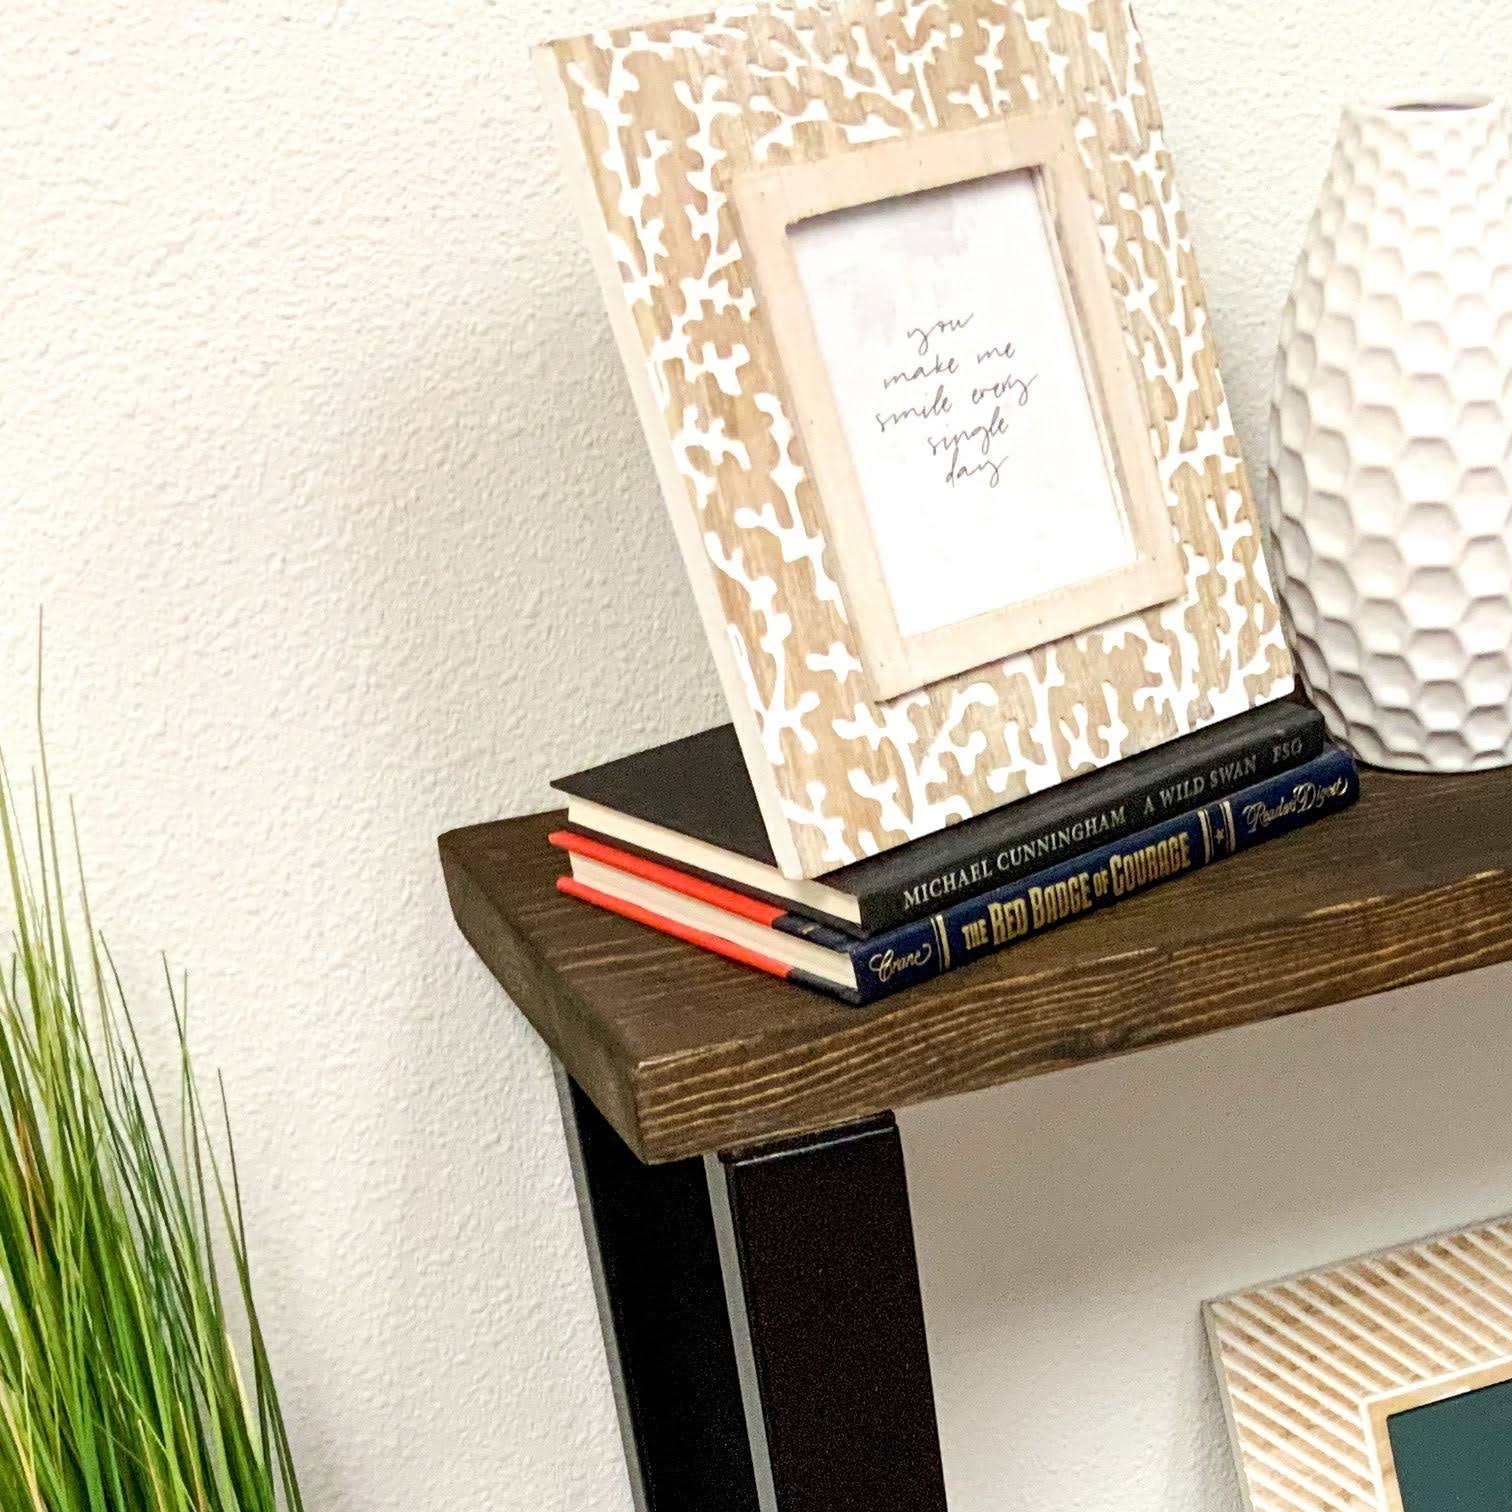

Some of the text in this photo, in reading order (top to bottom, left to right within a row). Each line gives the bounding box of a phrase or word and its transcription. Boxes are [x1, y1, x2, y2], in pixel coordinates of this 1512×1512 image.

[907, 313, 974, 355] you
[884, 342, 1015, 389] make me
[875, 374, 1038, 432] smile every
[927, 406, 1008, 456] single
[946, 448, 1008, 488] day
[903, 737, 1303, 910] MICHAEL CUNNINGHAM A WILD SWAN FSG
[869, 943, 932, 982] Crane
[962, 918, 989, 950] THE
[987, 897, 1029, 945] RED
[1028, 872, 1092, 929] BADGE
[1093, 868, 1109, 897] OF
[1109, 831, 1191, 896] COURAGE
[1293, 777, 1349, 814] Digest
